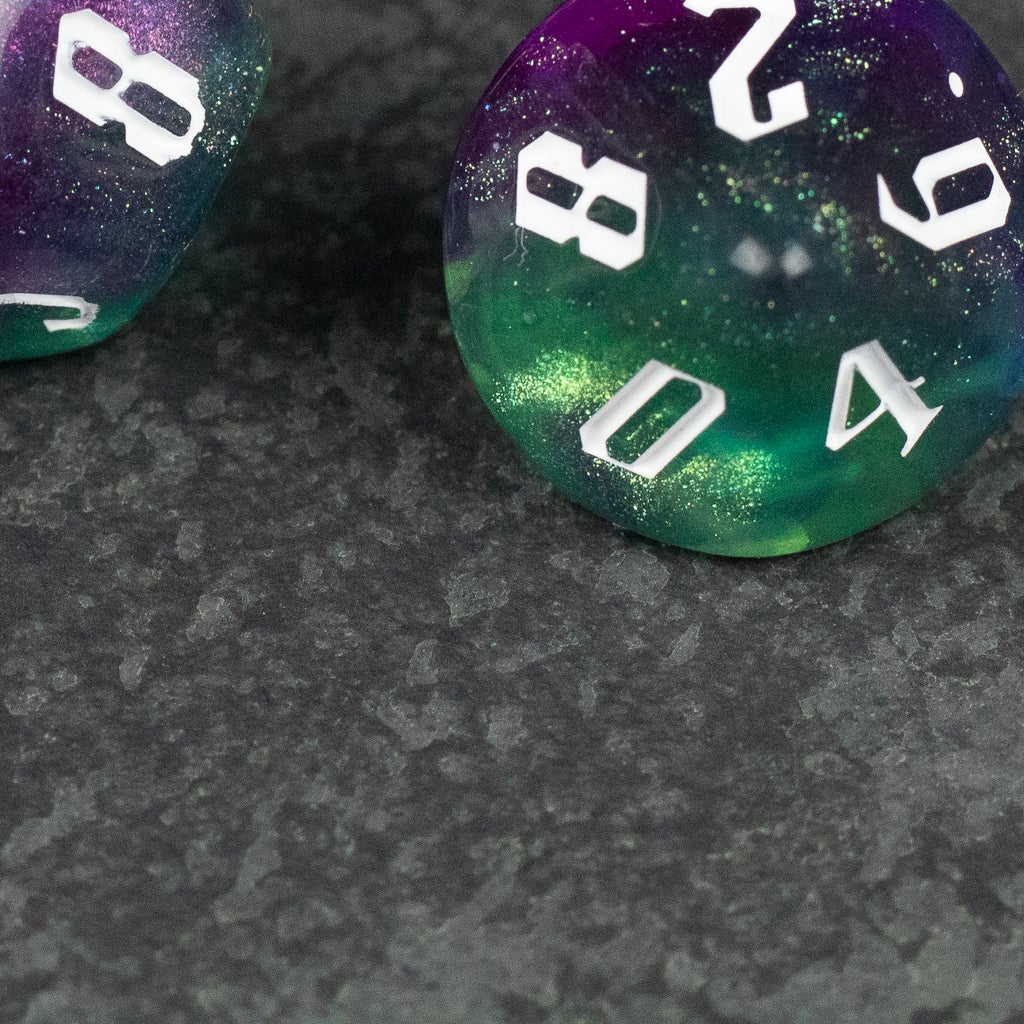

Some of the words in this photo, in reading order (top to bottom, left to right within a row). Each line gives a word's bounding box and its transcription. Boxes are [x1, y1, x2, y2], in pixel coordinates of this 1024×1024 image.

[51, 7, 207, 168] 8
[514, 130, 648, 272] 8
[578, 358, 726, 481] 0
[825, 338, 944, 459] 4
